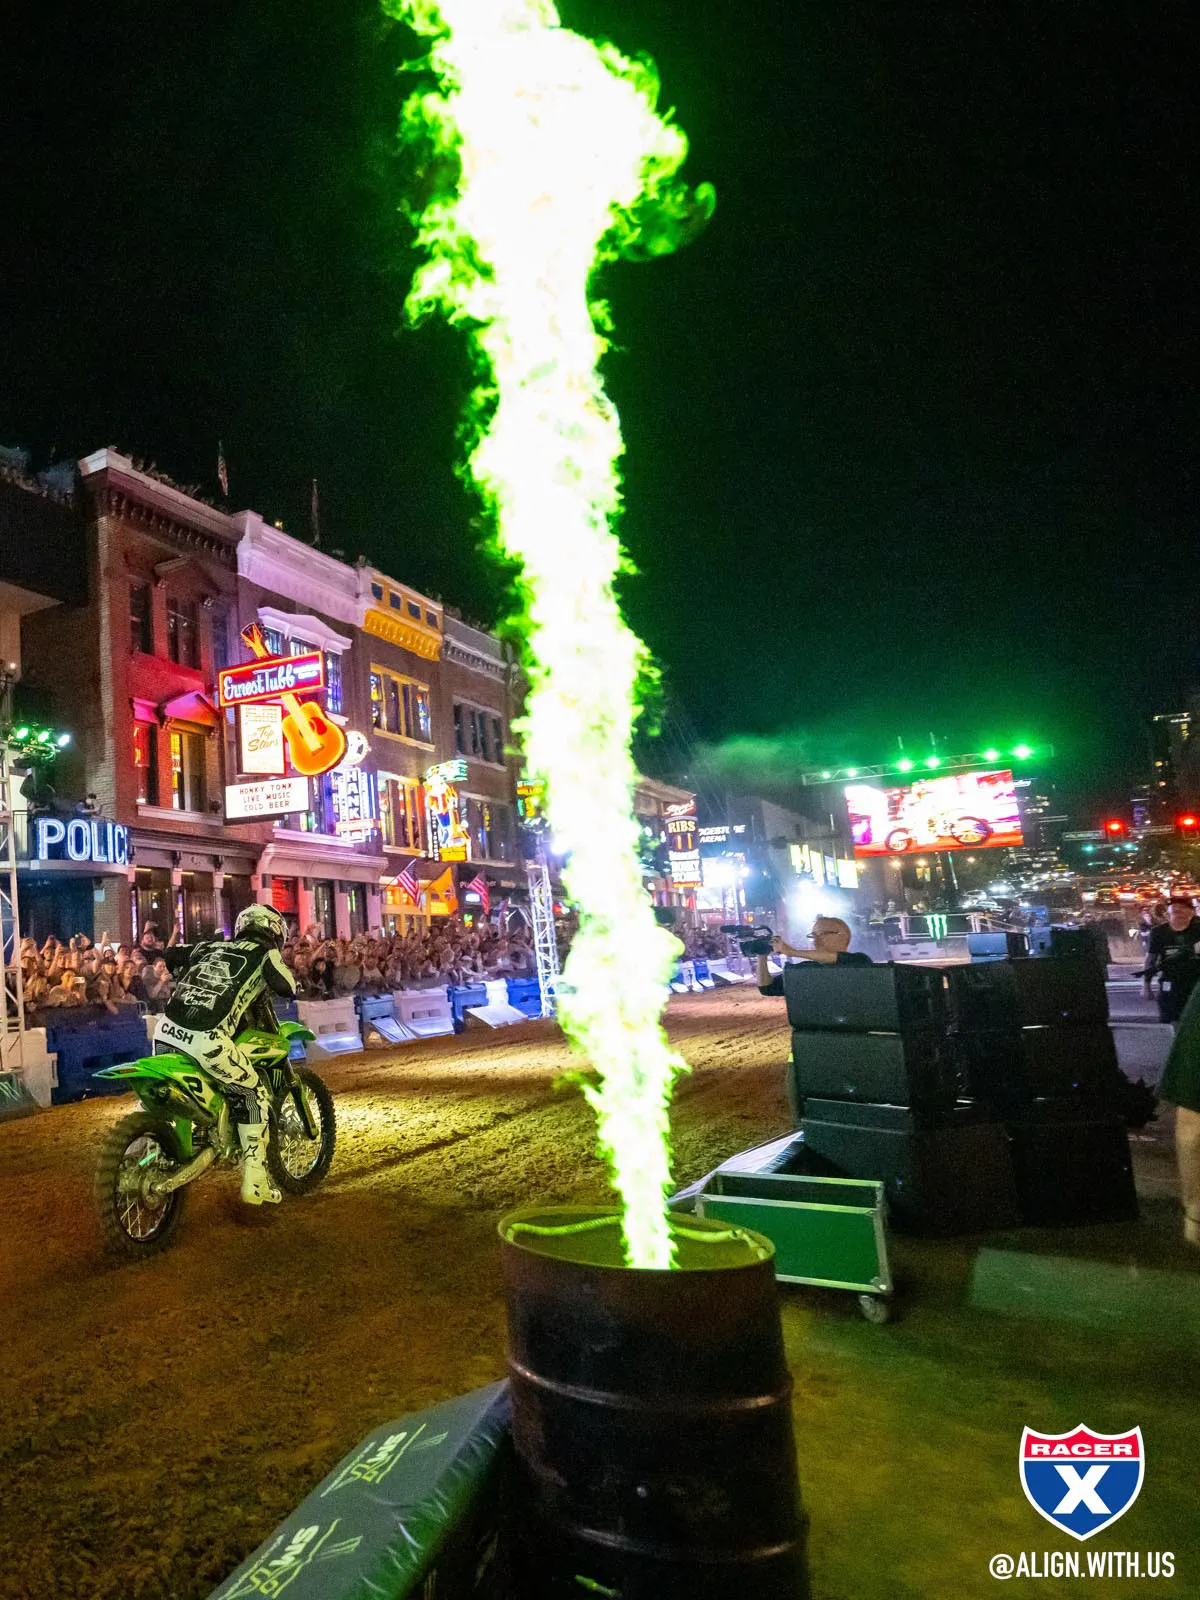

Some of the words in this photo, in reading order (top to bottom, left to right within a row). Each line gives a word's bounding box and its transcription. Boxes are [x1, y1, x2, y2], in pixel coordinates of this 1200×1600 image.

[223, 672, 265, 700] Ernest
[252, 664, 296, 693] Tubb
[239, 786, 265, 796] HONKY
[270, 782, 293, 793] TONK
[243, 794, 261, 804] LIVE
[265, 792, 291, 801] MUSIC
[244, 803, 264, 813] COLD
[269, 800, 291, 810] BEER
[667, 819, 696, 834] RIBS
[161, 1022, 194, 1045] CASH
